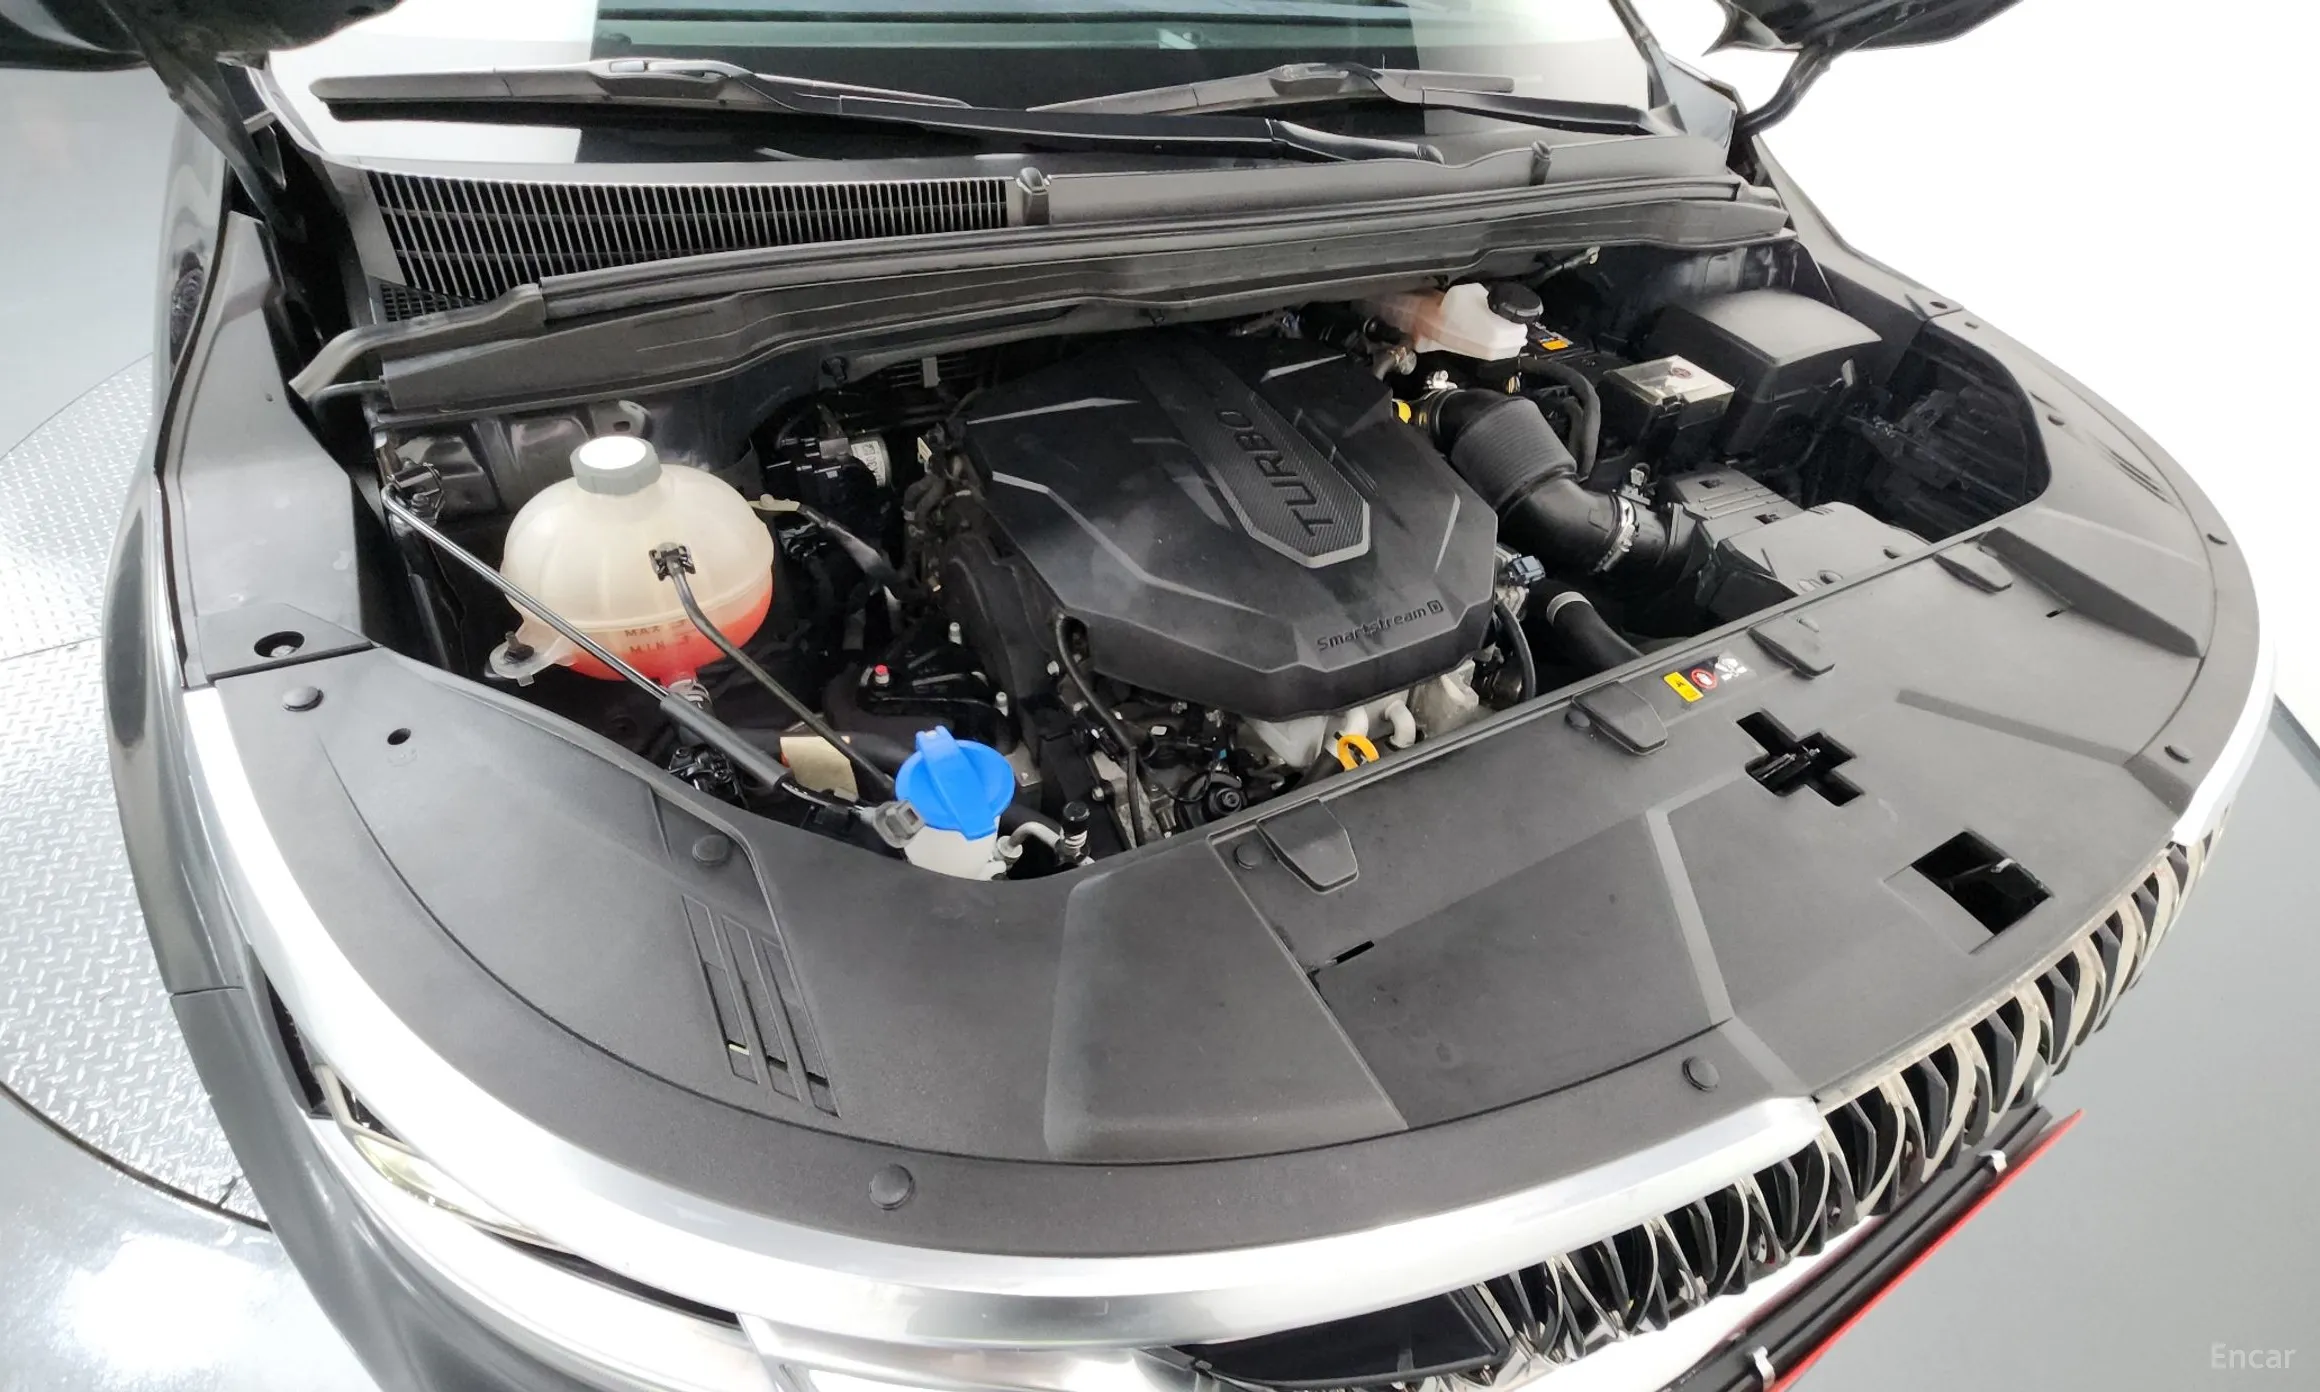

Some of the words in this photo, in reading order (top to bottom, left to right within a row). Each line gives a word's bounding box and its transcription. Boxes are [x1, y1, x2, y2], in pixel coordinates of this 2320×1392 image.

[1215, 409, 1335, 537] TURBO
[624, 625, 661, 637] MAX
[1317, 607, 1427, 651] Smartstream
[629, 640, 666, 654] MIN
